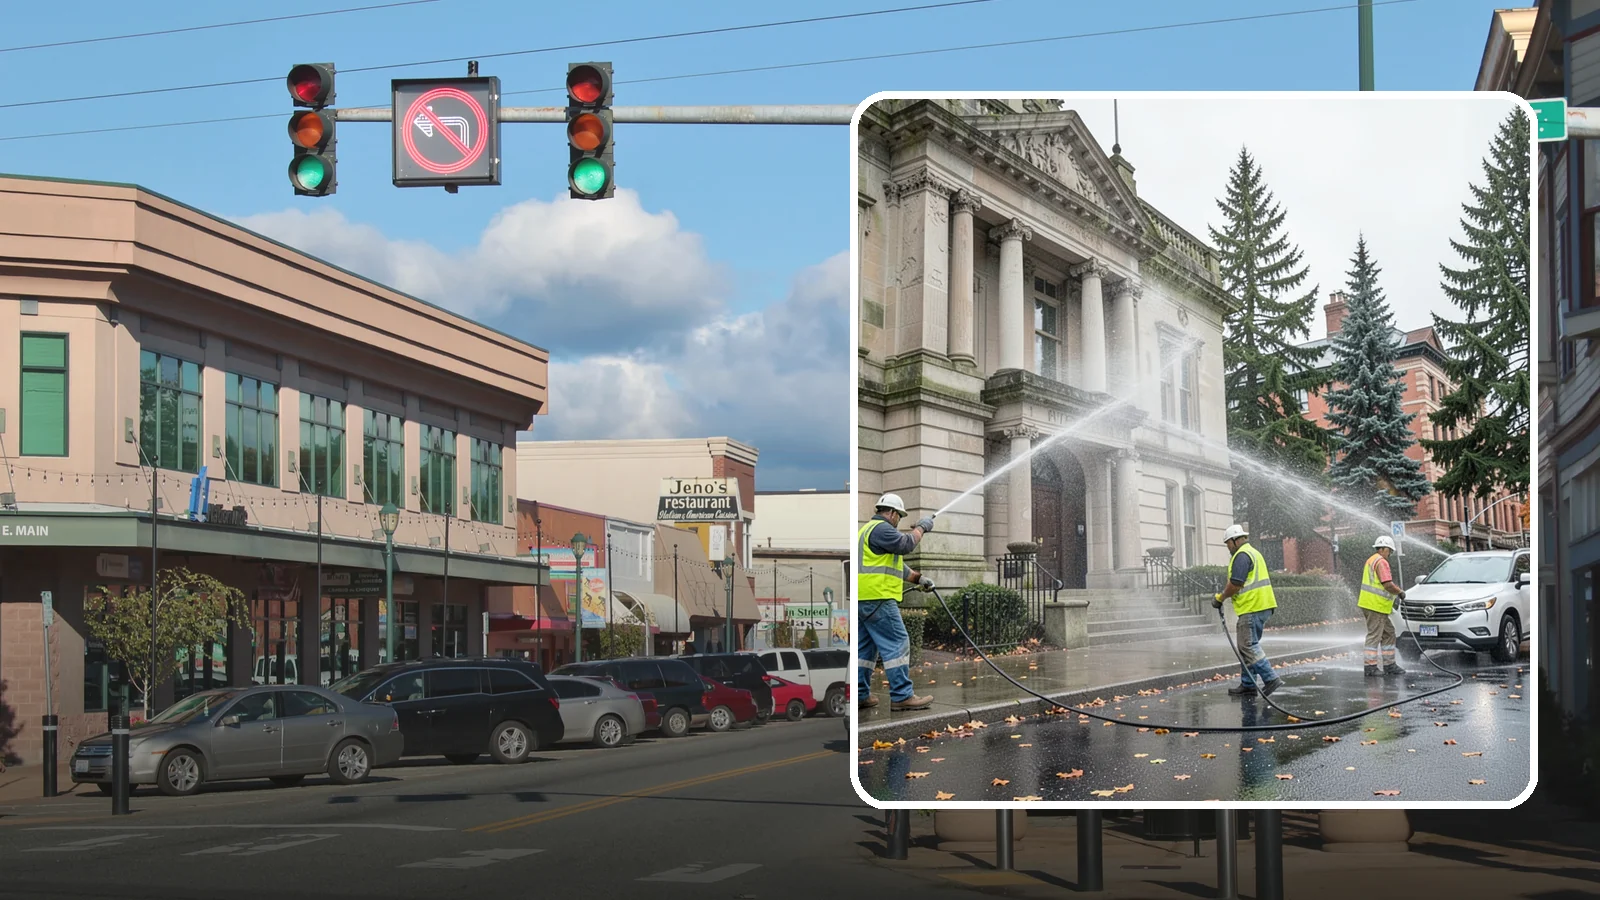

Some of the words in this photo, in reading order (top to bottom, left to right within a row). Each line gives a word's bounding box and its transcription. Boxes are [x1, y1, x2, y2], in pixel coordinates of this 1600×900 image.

[669, 480, 728, 494] Jeno's
[665, 496, 731, 509] restaurant
[658, 509, 681, 520] Italian
[686, 509, 715, 519] American
[715, 509, 738, 519] Cuisine
[2, 525, 13, 536] E.
[15, 525, 49, 536] MAIN
[797, 608, 828, 616] Street
